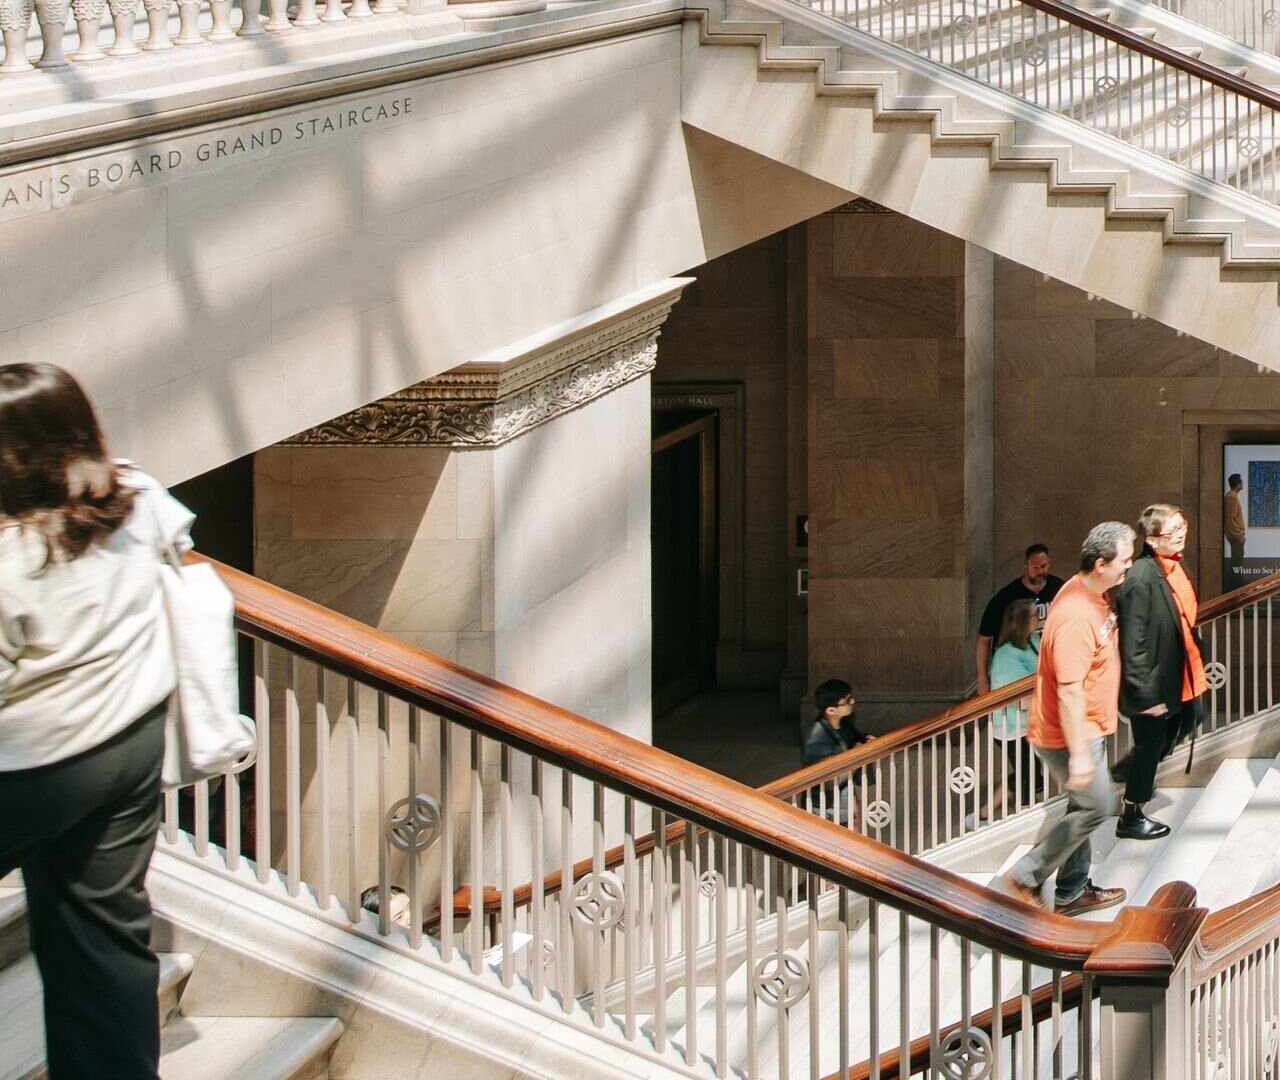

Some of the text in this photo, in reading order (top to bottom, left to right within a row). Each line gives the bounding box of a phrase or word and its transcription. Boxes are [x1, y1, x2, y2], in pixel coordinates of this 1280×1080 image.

[88, 150, 182, 188] BOARD
[197, 128, 283, 162] GRAND
[295, 98, 413, 140] STAIRCASE
[689, 396, 714, 405] HALL
[1232, 566, 1252, 575] What
[1262, 566, 1274, 574] See
